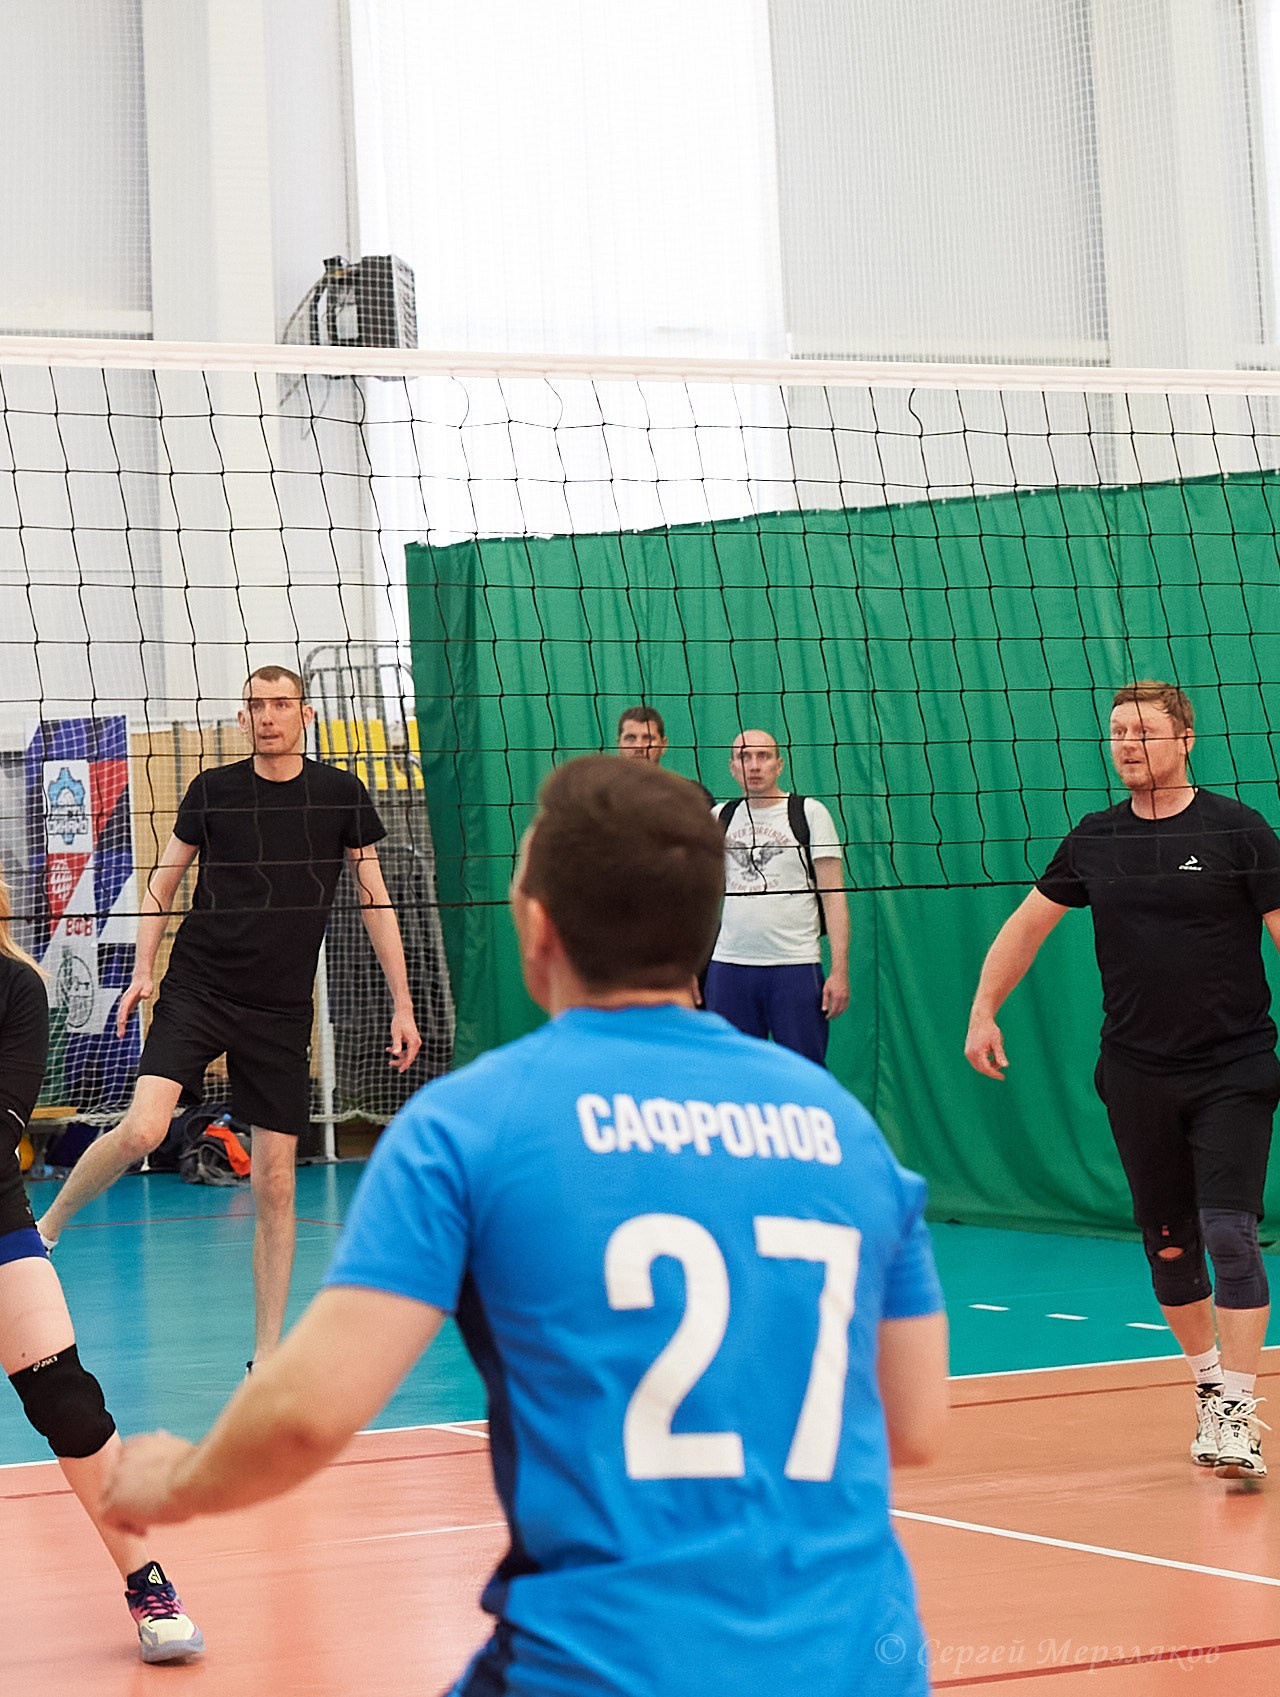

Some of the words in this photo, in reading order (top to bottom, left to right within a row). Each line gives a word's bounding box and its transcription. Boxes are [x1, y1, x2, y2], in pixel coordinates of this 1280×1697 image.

[65, 918, 93, 936] ВФВ
[577, 1093, 842, 1165] САФРОНОВ
[604, 1213, 862, 1481] 27
